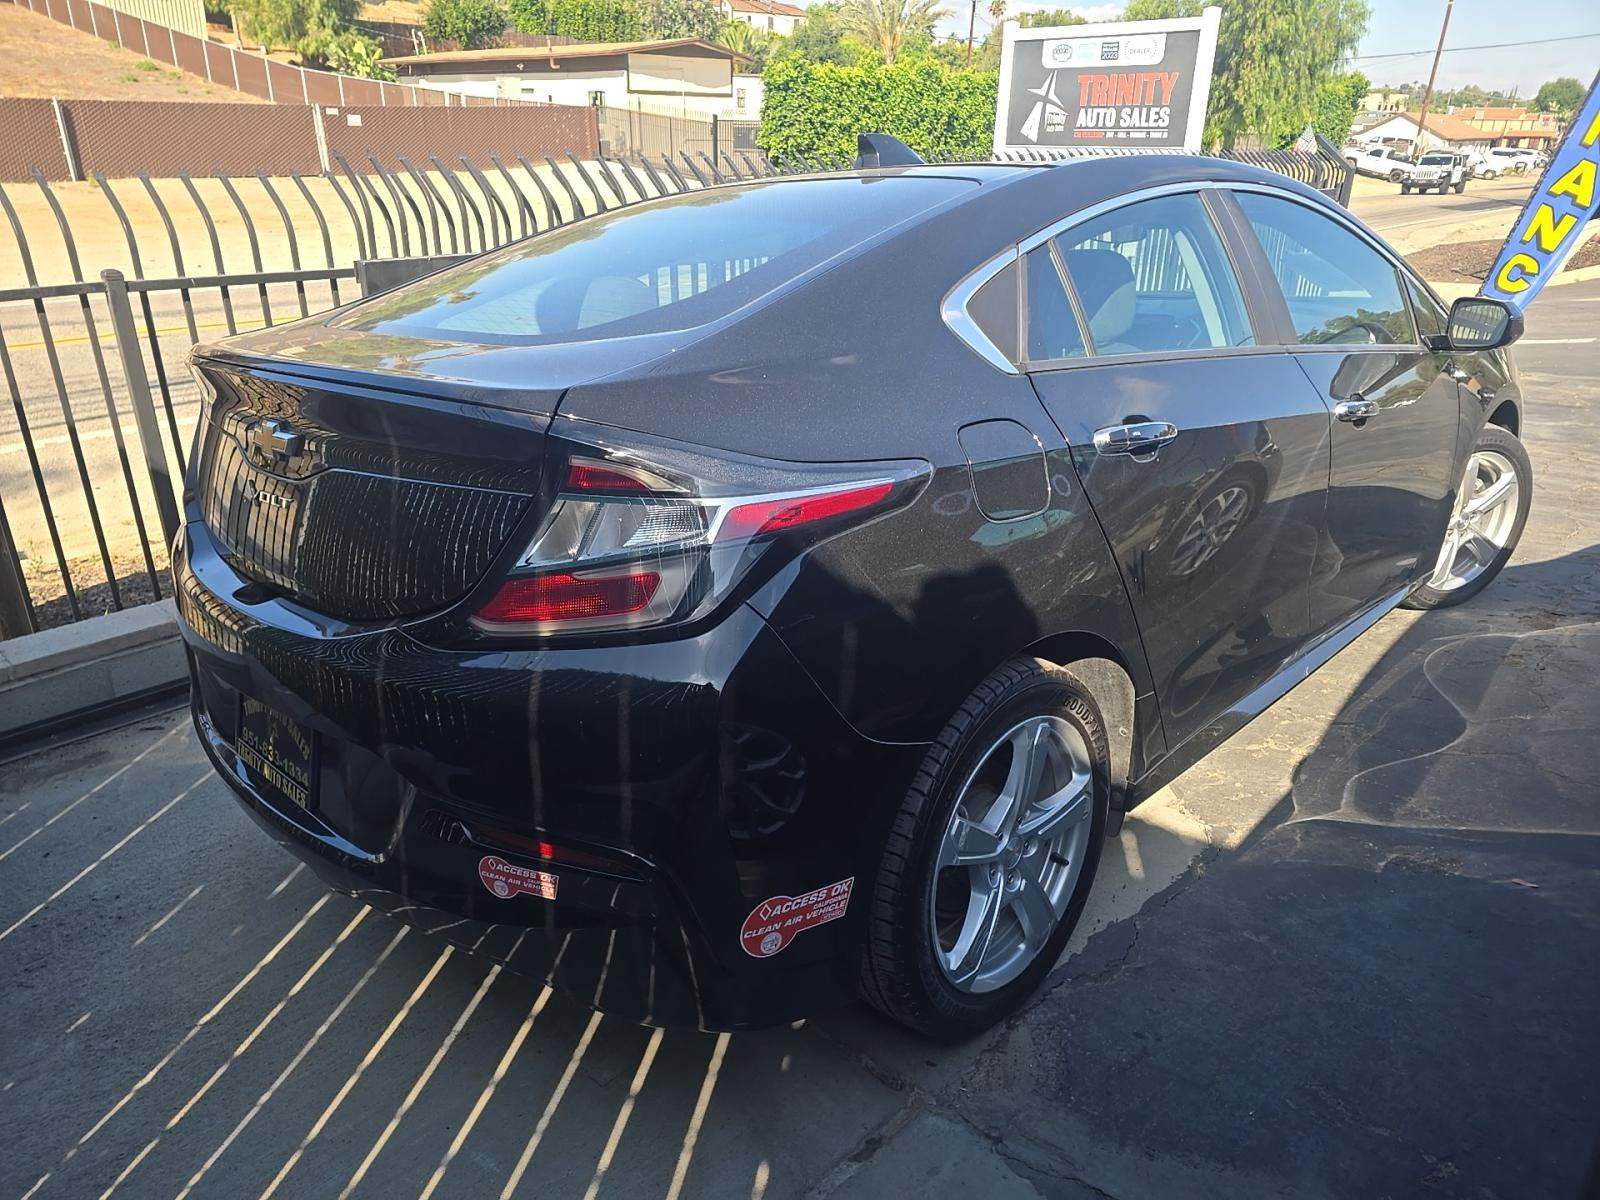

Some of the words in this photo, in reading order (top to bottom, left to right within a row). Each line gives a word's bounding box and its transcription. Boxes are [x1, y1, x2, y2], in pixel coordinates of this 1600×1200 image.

[1078, 72, 1179, 106] TRINITY
[1077, 107, 1116, 128] AUTO
[1120, 107, 1170, 128] SALES
[248, 478, 295, 508] VOLT
[481, 871, 506, 882] CLEAN
[507, 878, 521, 886] AIR
[496, 864, 537, 879] ACCESS
[540, 873, 556, 884] OK
[771, 889, 828, 917] ACCESS
[831, 881, 850, 896] OK
[743, 922, 782, 939] CLEAN
[784, 915, 803, 928] AIR
[806, 901, 846, 919] VEHICLE
